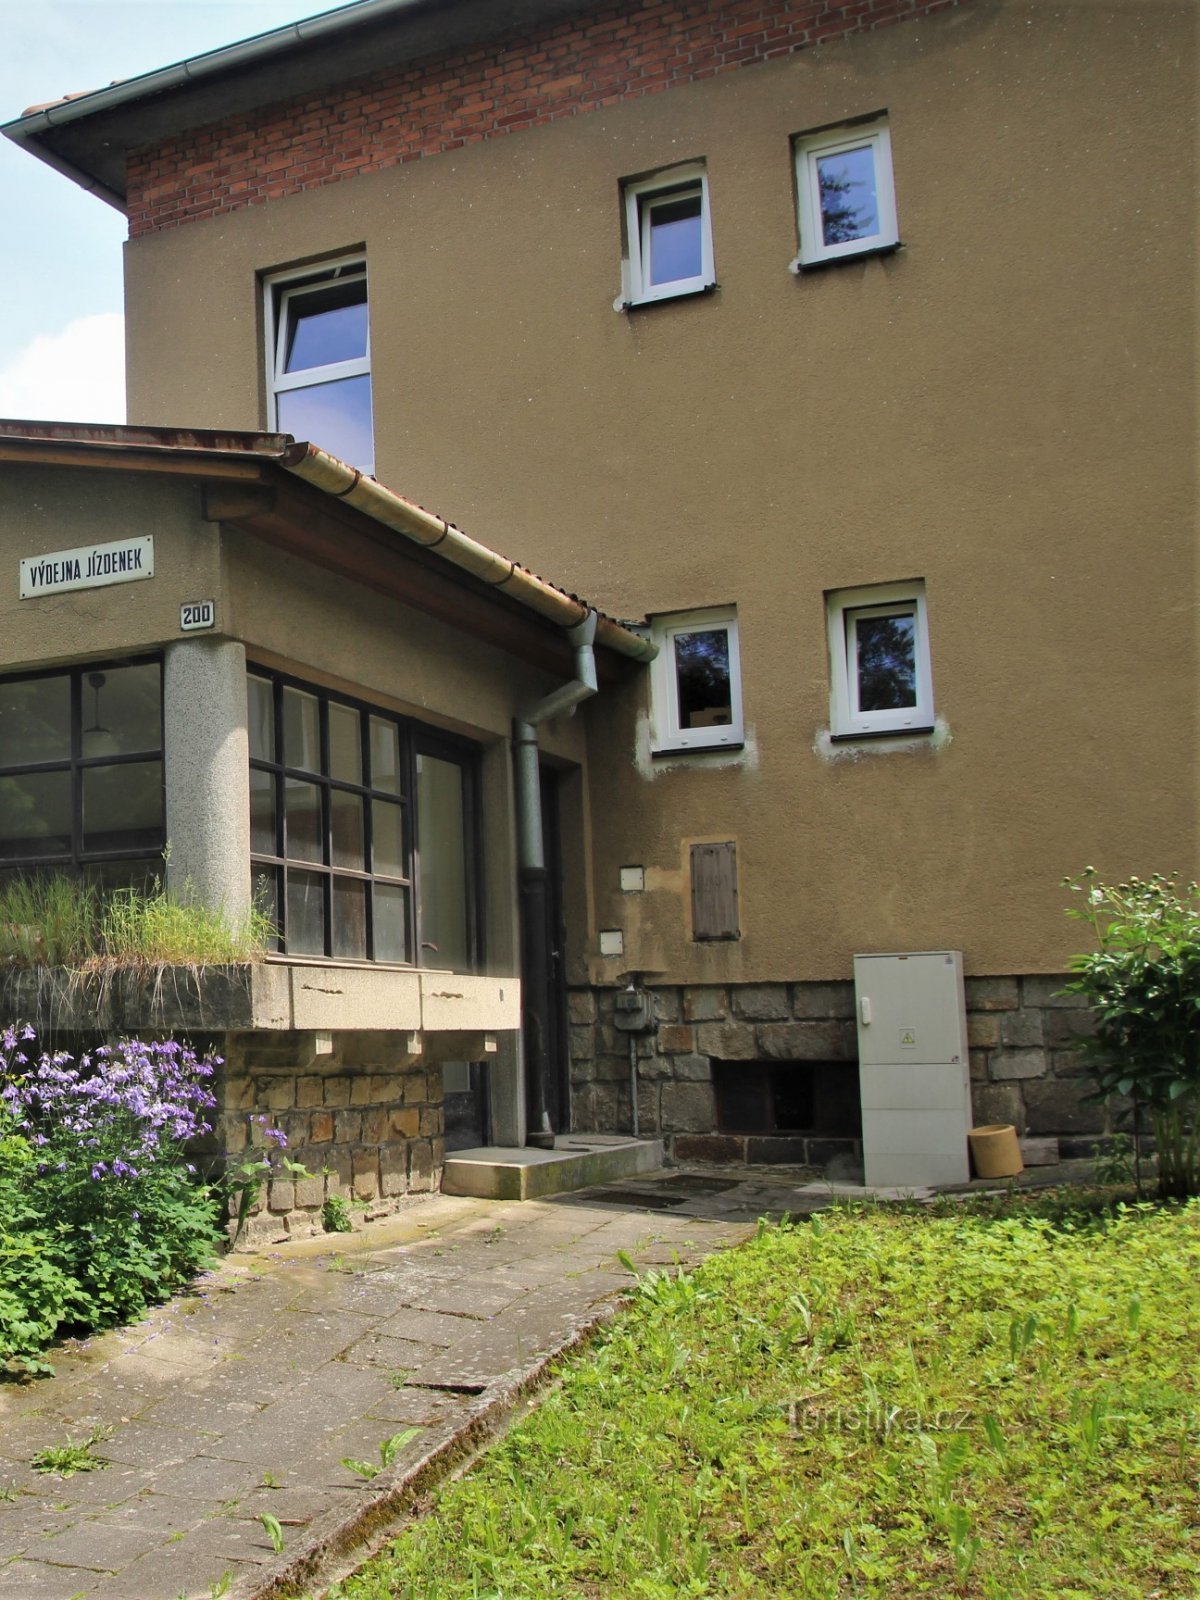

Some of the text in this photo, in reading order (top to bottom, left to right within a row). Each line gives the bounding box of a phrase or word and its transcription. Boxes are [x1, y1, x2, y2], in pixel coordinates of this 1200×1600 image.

[30, 548, 142, 587] VÝDEJNA JÍZDENEK
[183, 604, 210, 625] 200
